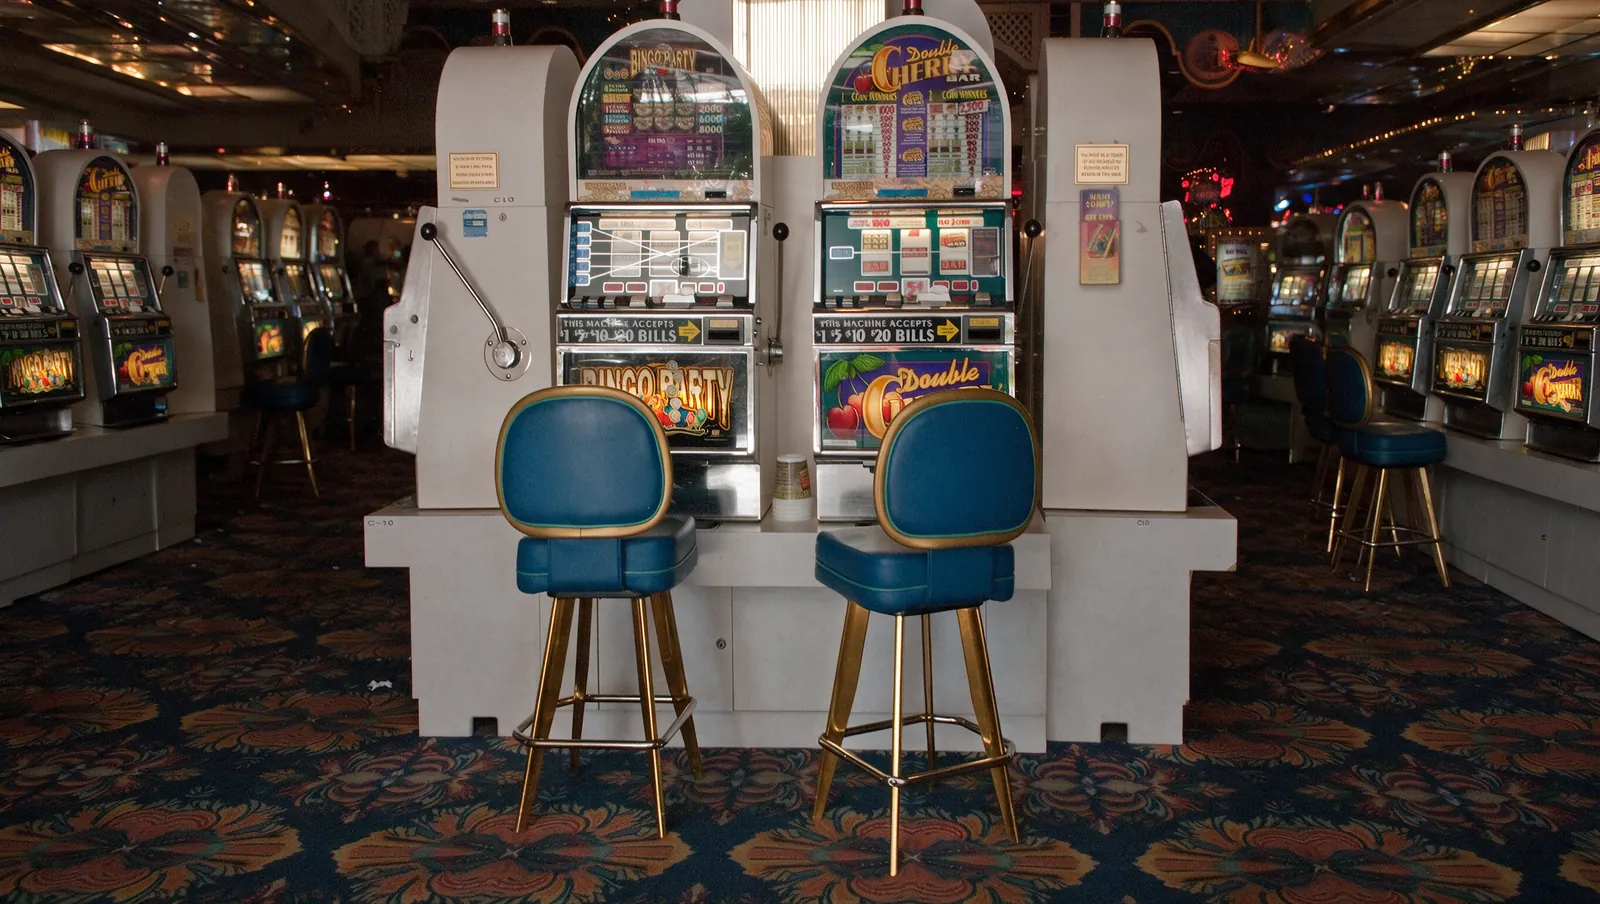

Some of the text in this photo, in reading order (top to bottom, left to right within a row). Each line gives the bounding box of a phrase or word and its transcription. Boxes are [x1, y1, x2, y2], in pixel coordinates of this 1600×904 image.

[906, 38, 959, 62] Double
[630, 49, 696, 76] BINGO PARTY
[960, 101, 984, 113] 2,500
[699, 125, 723, 134] 8000
[563, 320, 583, 328] THIS
[632, 320, 675, 328] ACCEPTS
[820, 320, 933, 328] THIS MACHINE ACCEPTS
[638, 329, 677, 342] BILLS
[871, 329, 892, 342] $20
[895, 329, 935, 342] BILLS
[896, 357, 980, 393] Double
[658, 366, 735, 431] PARTY
